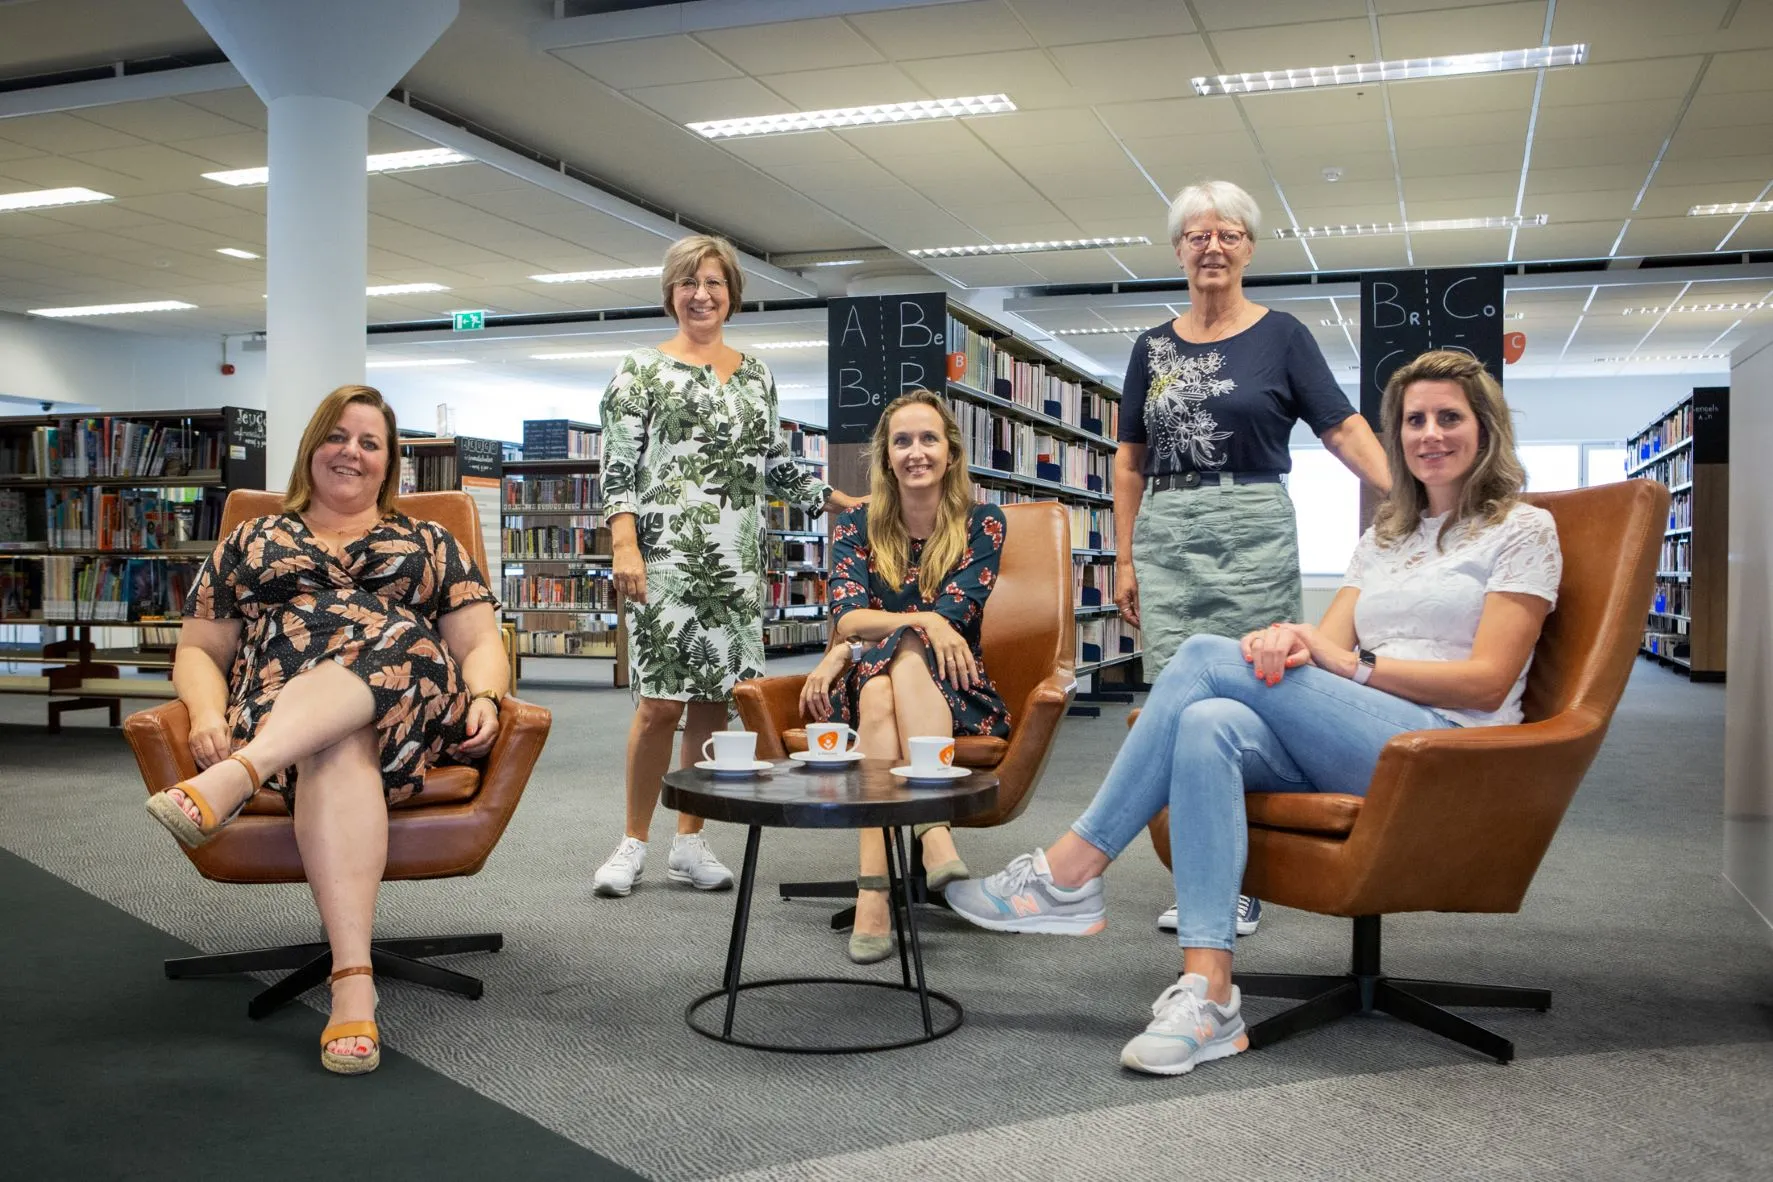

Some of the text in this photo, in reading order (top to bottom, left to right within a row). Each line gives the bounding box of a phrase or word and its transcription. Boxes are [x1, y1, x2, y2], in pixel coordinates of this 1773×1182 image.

[840, 304, 867, 347] A
[899, 301, 944, 348] Be
[1511, 335, 1522, 349] C
[955, 355, 965, 368] B
[838, 368, 881, 408] Be
